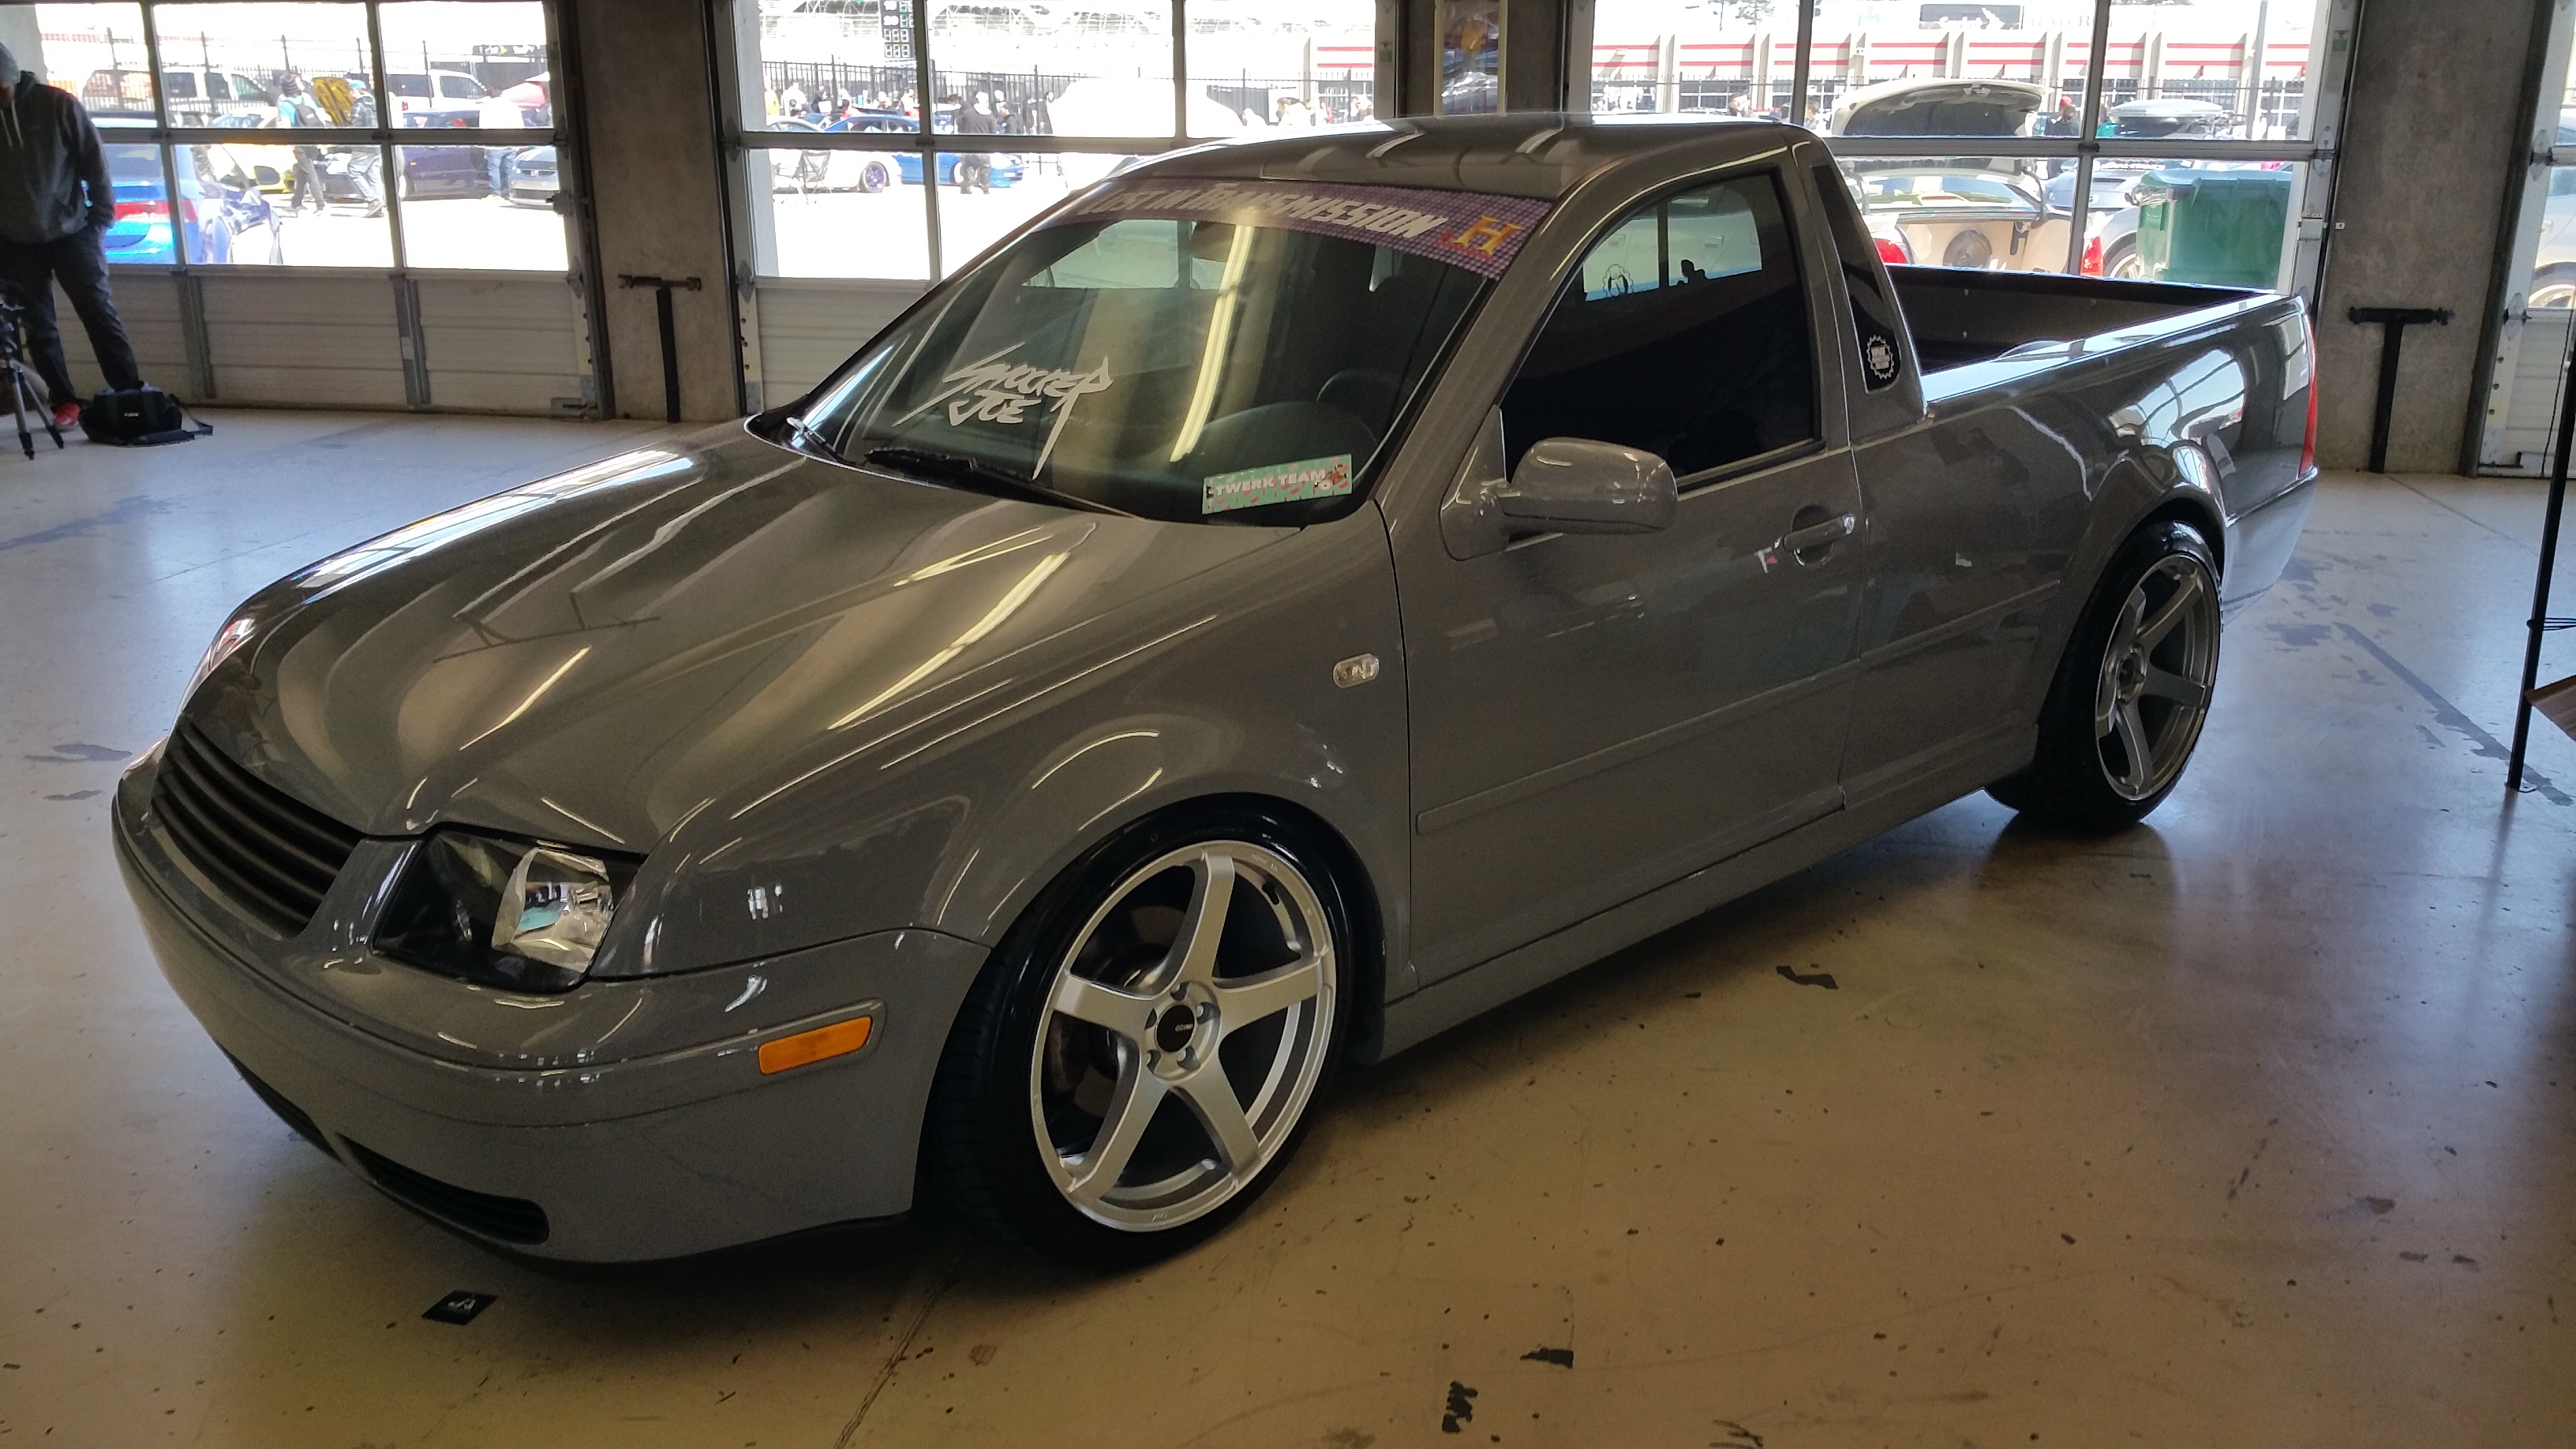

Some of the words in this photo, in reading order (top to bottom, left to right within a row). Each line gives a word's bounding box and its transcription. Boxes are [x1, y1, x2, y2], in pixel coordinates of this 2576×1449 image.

[949, 389, 1042, 426] JOE
[1215, 477, 1275, 496] TWERK
[1278, 469, 1327, 486] TEAM
